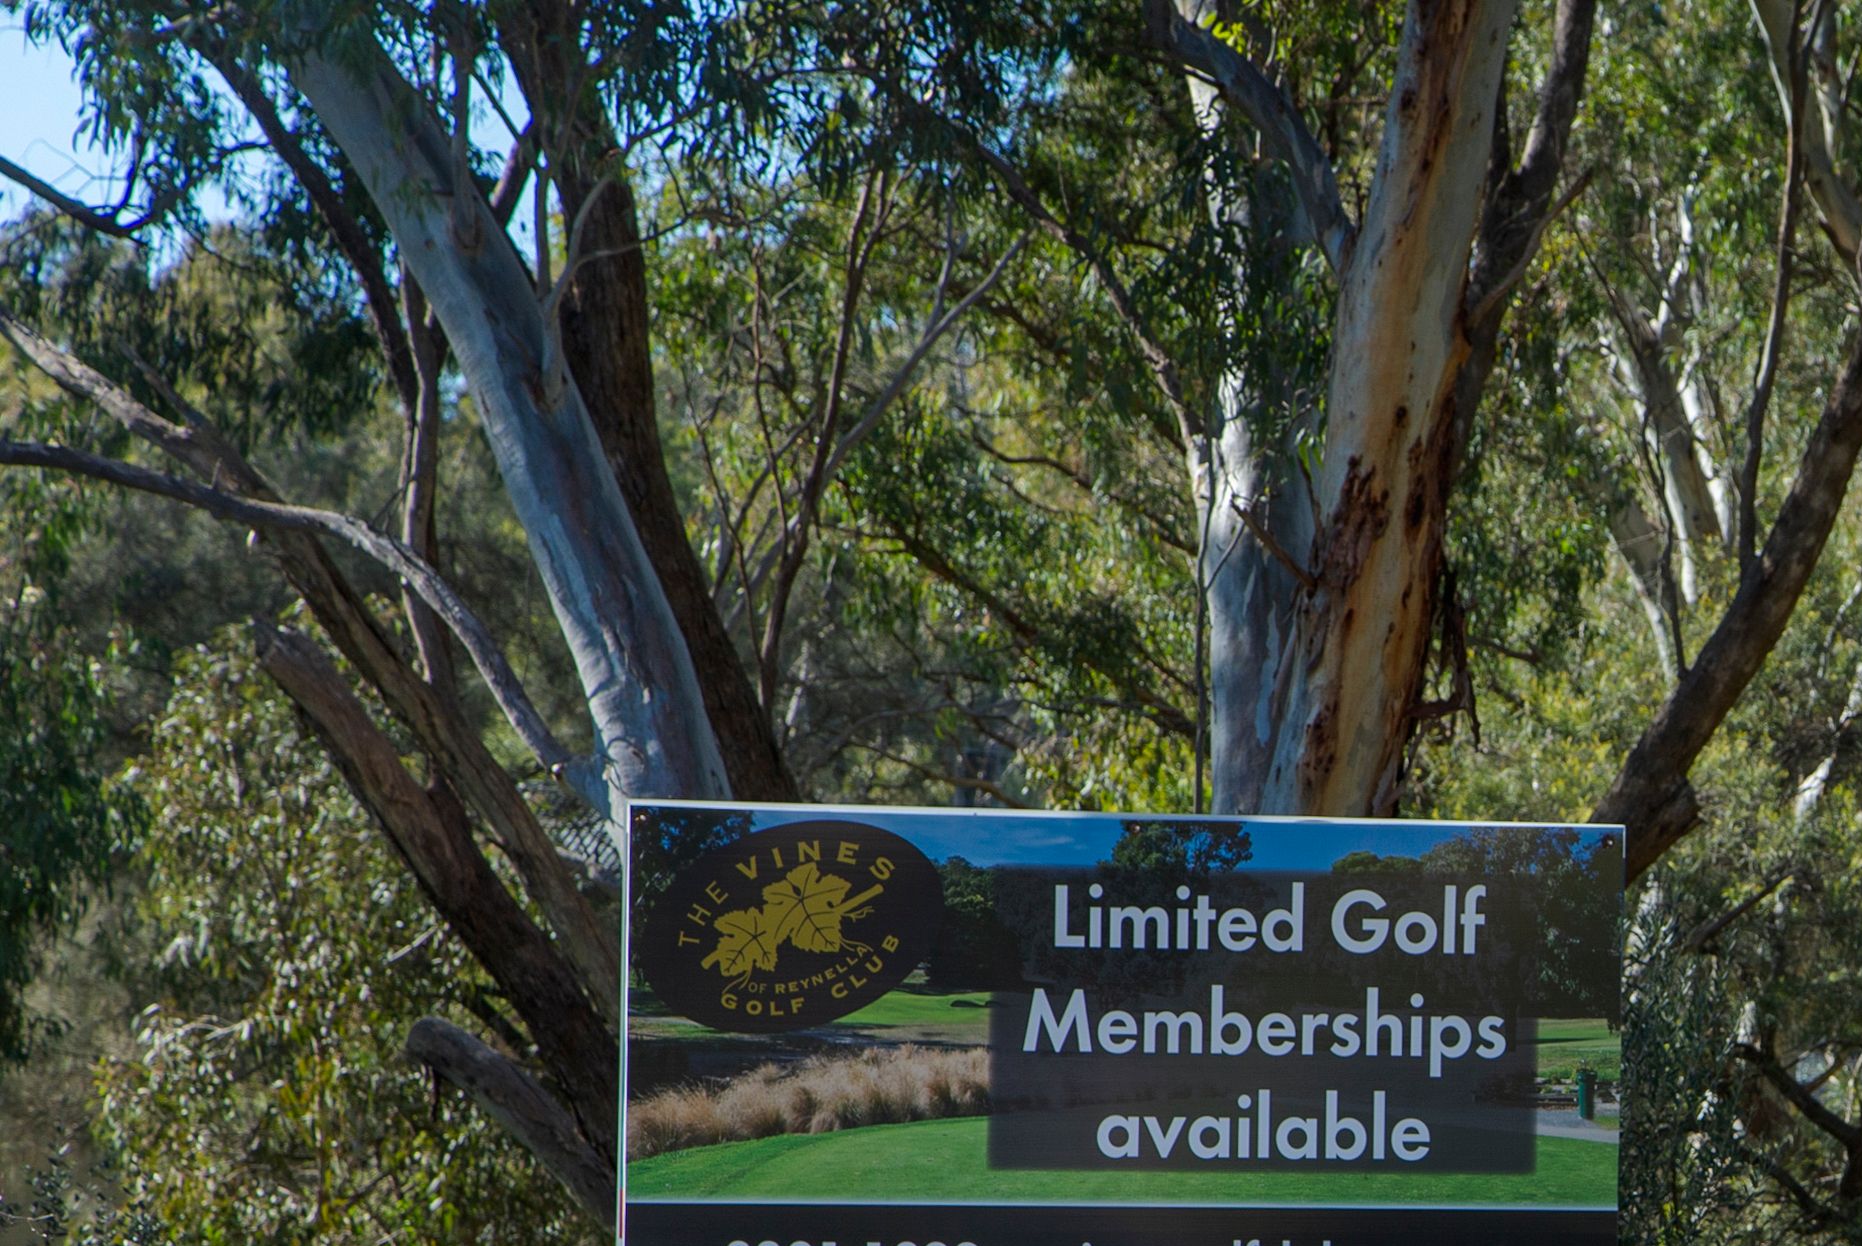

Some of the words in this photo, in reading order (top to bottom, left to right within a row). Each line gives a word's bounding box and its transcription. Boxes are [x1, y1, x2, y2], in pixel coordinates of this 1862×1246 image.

[678, 880, 729, 947] THE
[735, 840, 896, 881] VINES
[1054, 881, 1305, 953] Limited
[1330, 883, 1486, 955] Golf
[720, 993, 805, 1016] GOLF
[831, 934, 899, 999] CLUB
[749, 982, 767, 994] OF
[774, 944, 871, 994] REYNELLA
[1022, 984, 1507, 1077] Memberships
[1096, 1089, 1431, 1161] available
